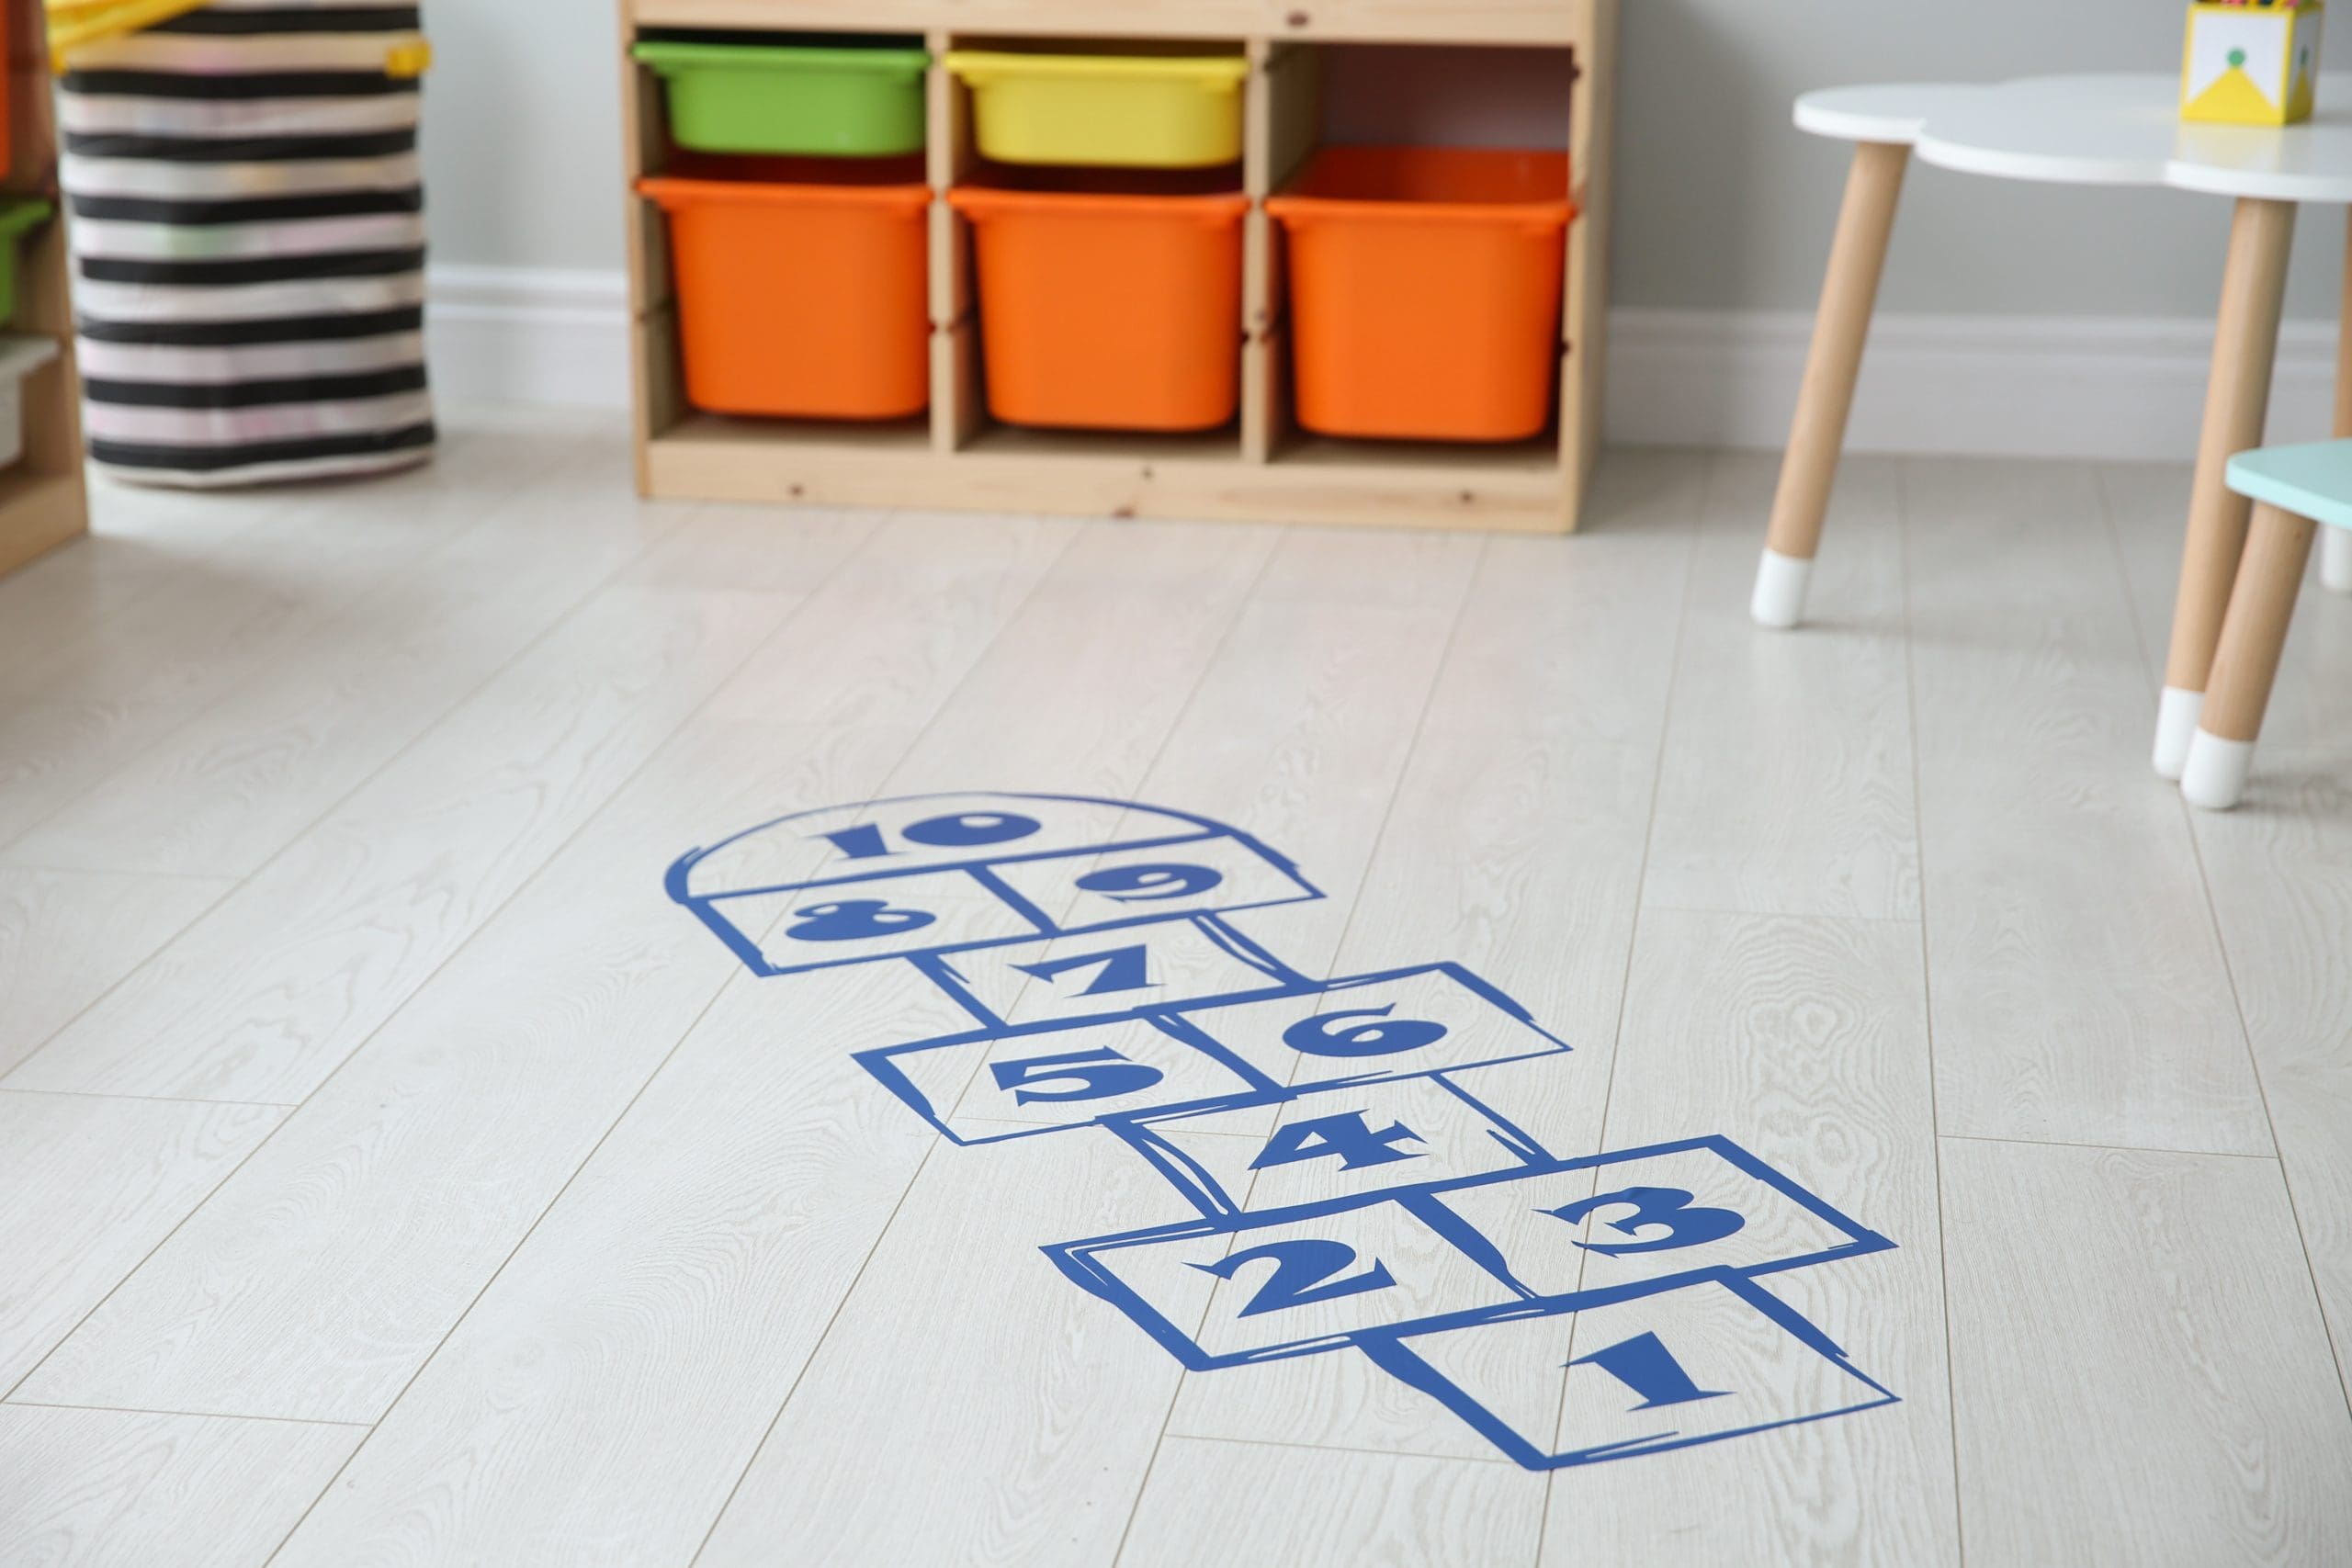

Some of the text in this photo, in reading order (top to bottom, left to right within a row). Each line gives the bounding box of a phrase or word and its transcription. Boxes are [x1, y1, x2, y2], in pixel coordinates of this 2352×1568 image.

[808, 811, 1042, 861] 10
[1074, 863, 1224, 902] 9
[785, 899, 937, 942] 8
[1007, 943, 1165, 998] 7
[1282, 1003, 1448, 1058] 6
[989, 1045, 1165, 1107] 5
[1248, 1110, 1427, 1172] 4
[1532, 1185, 1747, 1257] 3
[1182, 1239, 1396, 1319] 2
[1559, 1331, 1735, 1411] 1
